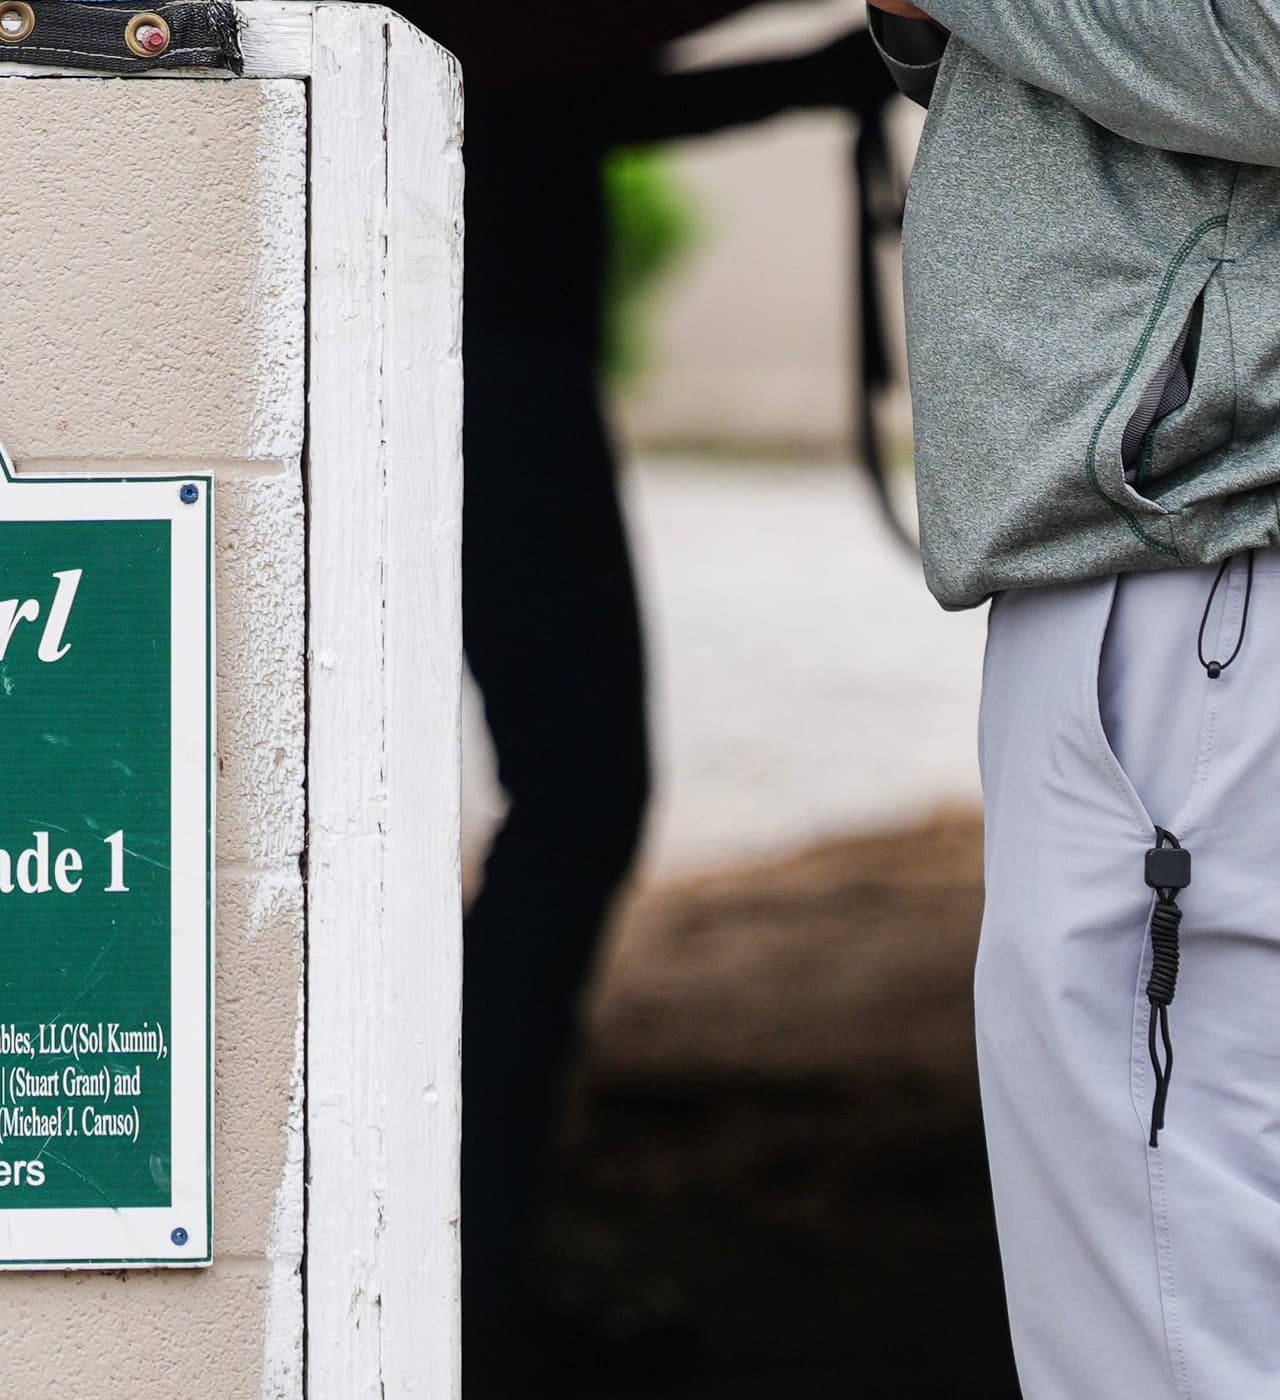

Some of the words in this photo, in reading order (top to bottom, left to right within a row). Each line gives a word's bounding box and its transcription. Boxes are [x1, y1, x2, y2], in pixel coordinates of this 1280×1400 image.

[103, 829, 130, 892] 1
[107, 1022, 168, 1060] Kumin),
[9, 1066, 60, 1105] (Stuart
[62, 1065, 111, 1104] Grant)
[114, 1065, 141, 1096] and
[65, 1106, 78, 1137] J.
[81, 1105, 140, 1143] Caruso)
